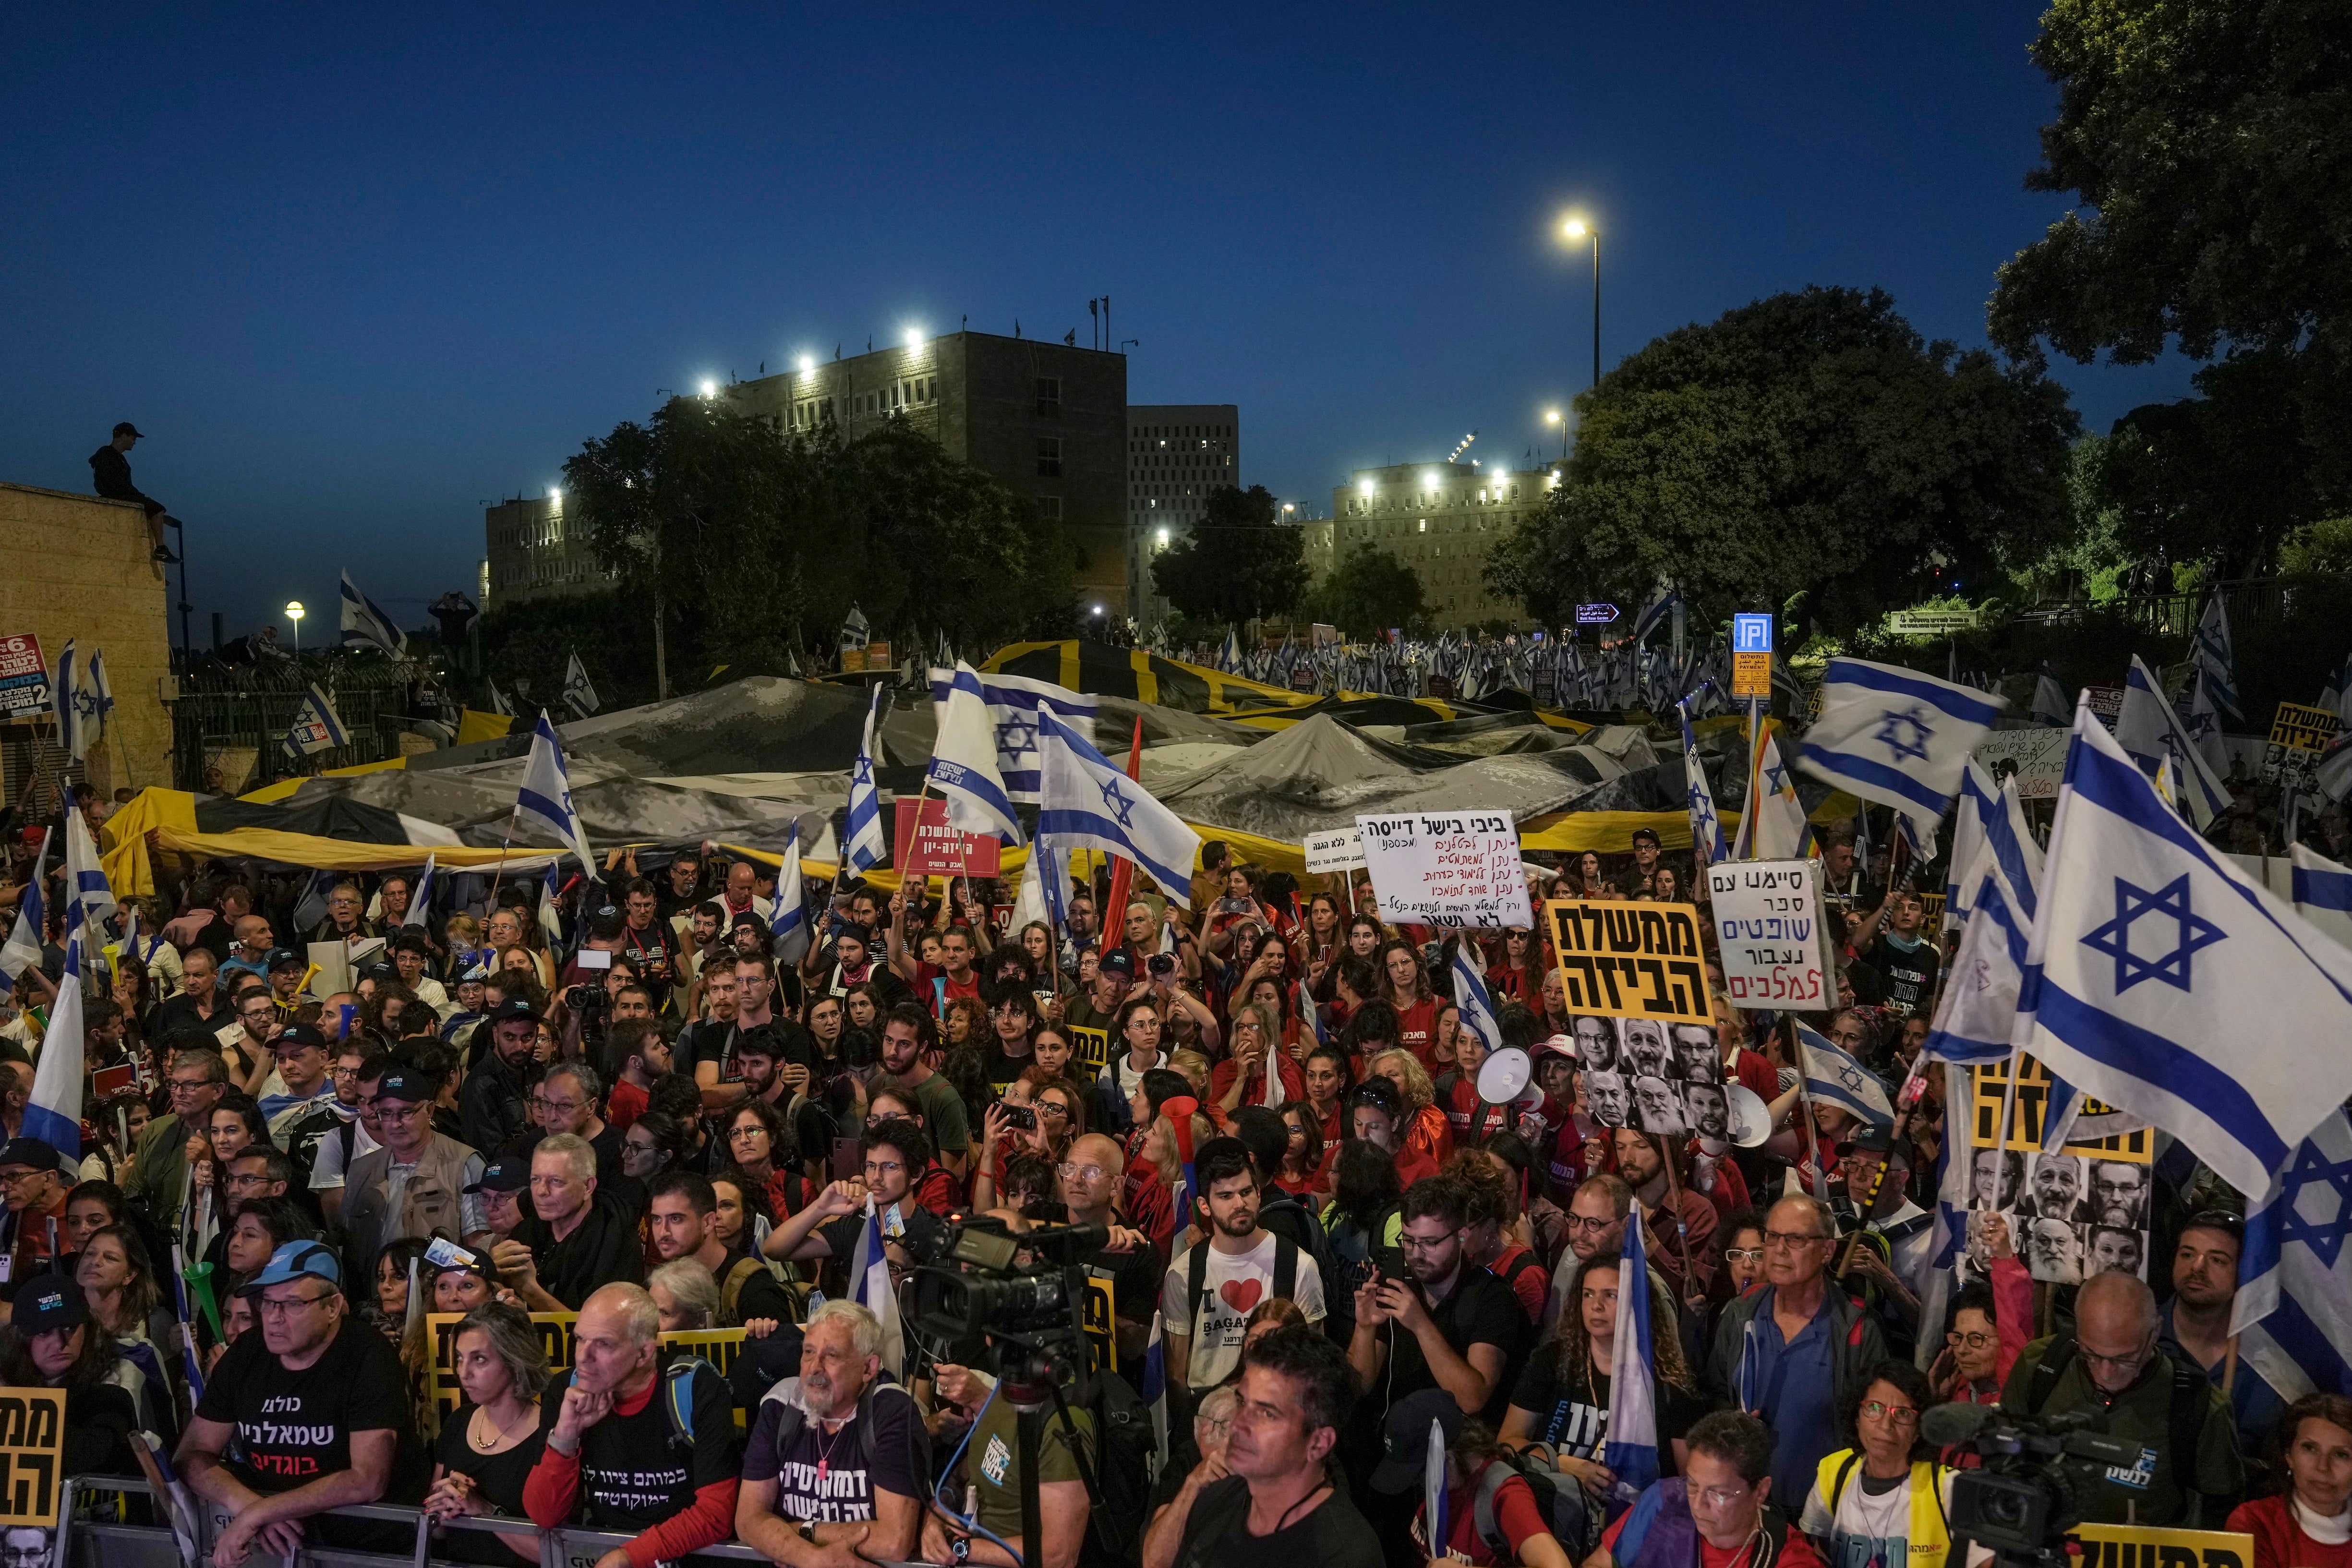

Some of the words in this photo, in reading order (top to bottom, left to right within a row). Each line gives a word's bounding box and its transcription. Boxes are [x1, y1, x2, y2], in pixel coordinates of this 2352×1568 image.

[7, 638, 26, 652] 6
[33, 684, 50, 704] 2
[2109, 691, 2124, 701] 6
[2277, 706, 2339, 732] ממשלת
[2055, 728, 2063, 738] 4
[2271, 723, 2336, 751] הביזה
[2032, 742, 2045, 751] 20
[1422, 817, 1465, 836] בישל
[1471, 817, 1507, 834] ביבי
[924, 842, 973, 856] היזה-יון
[1313, 842, 1328, 851] הגנה
[1331, 837, 1345, 848] ללא
[1435, 836, 1478, 853] לבטלנים
[1438, 853, 1486, 866] למשתמטים
[1492, 856, 1509, 871] נתן
[1457, 867, 1486, 880] ללימודי
[1492, 869, 1511, 884] נתן
[1746, 871, 1803, 890] סיימנו
[1496, 883, 1513, 897] נתן
[1713, 876, 1736, 892] עם
[1446, 903, 1471, 912] המיסים
[1474, 898, 1503, 911] למשלמי
[1506, 903, 1520, 913] ורק
[1763, 896, 1804, 912] ספר
[1421, 915, 1467, 927] נשאר
[1475, 912, 1501, 927] לא
[1555, 904, 1698, 957] ממשלת
[1563, 955, 1709, 1017] הביזה
[1728, 966, 1823, 1000] למלכים
[1403, 1031, 1426, 1039] מאבק
[38, 1294, 62, 1304] חופשי
[39, 1301, 63, 1311] בארצנו
[1202, 1289, 1216, 1314] I
[251, 1451, 319, 1475] בוגדים
[634, 1468, 687, 1486] במותם
[2105, 1466, 2151, 1486] לנשק
[844, 1502, 872, 1521] זה
